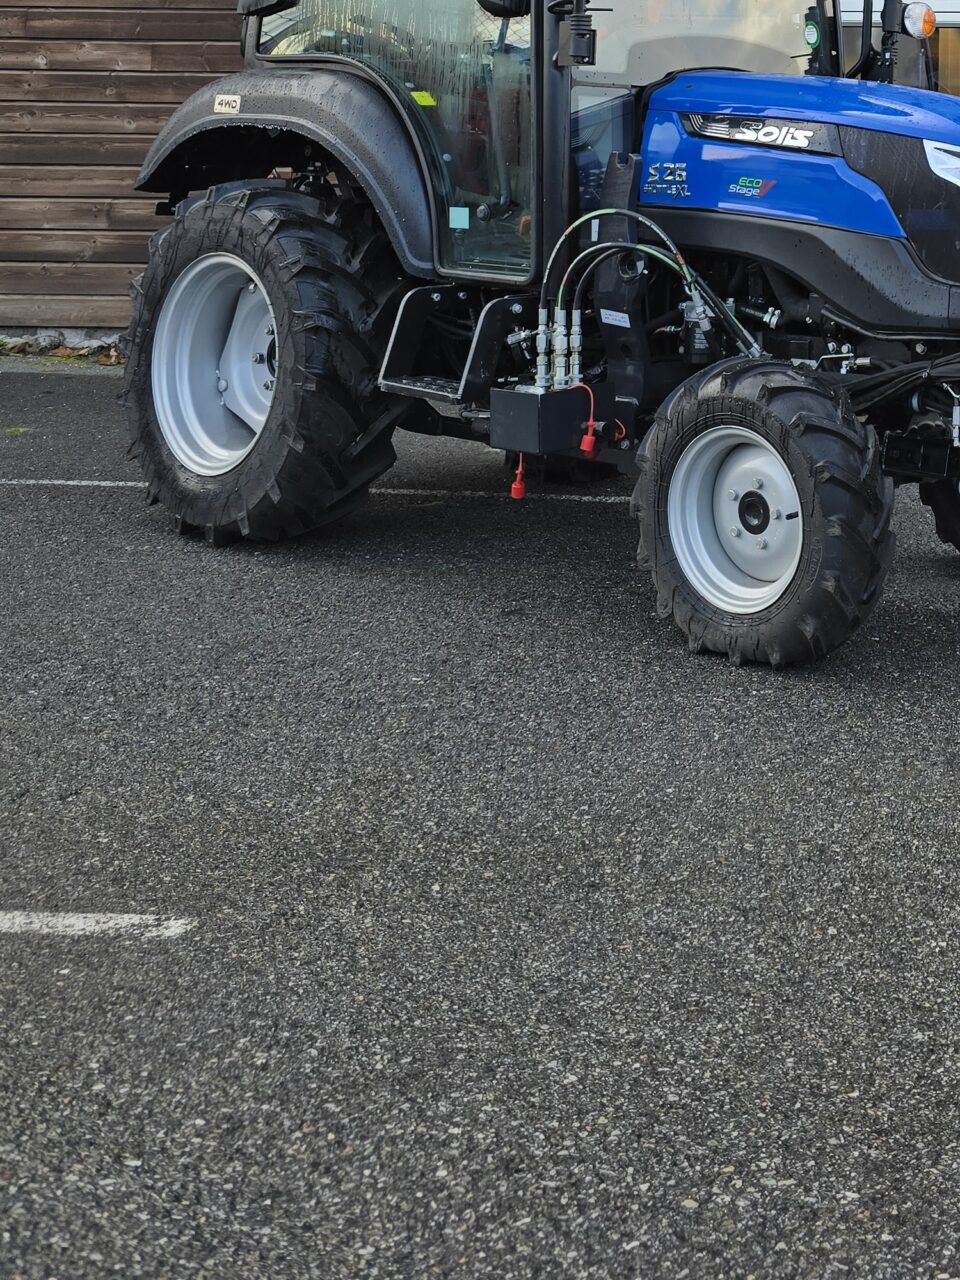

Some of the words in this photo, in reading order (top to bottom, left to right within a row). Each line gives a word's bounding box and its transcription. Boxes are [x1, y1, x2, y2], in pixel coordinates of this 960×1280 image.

[218, 99, 238, 109] 4WD
[735, 121, 814, 148] Solis
[647, 162, 661, 182] S
[738, 177, 762, 188] ECO
